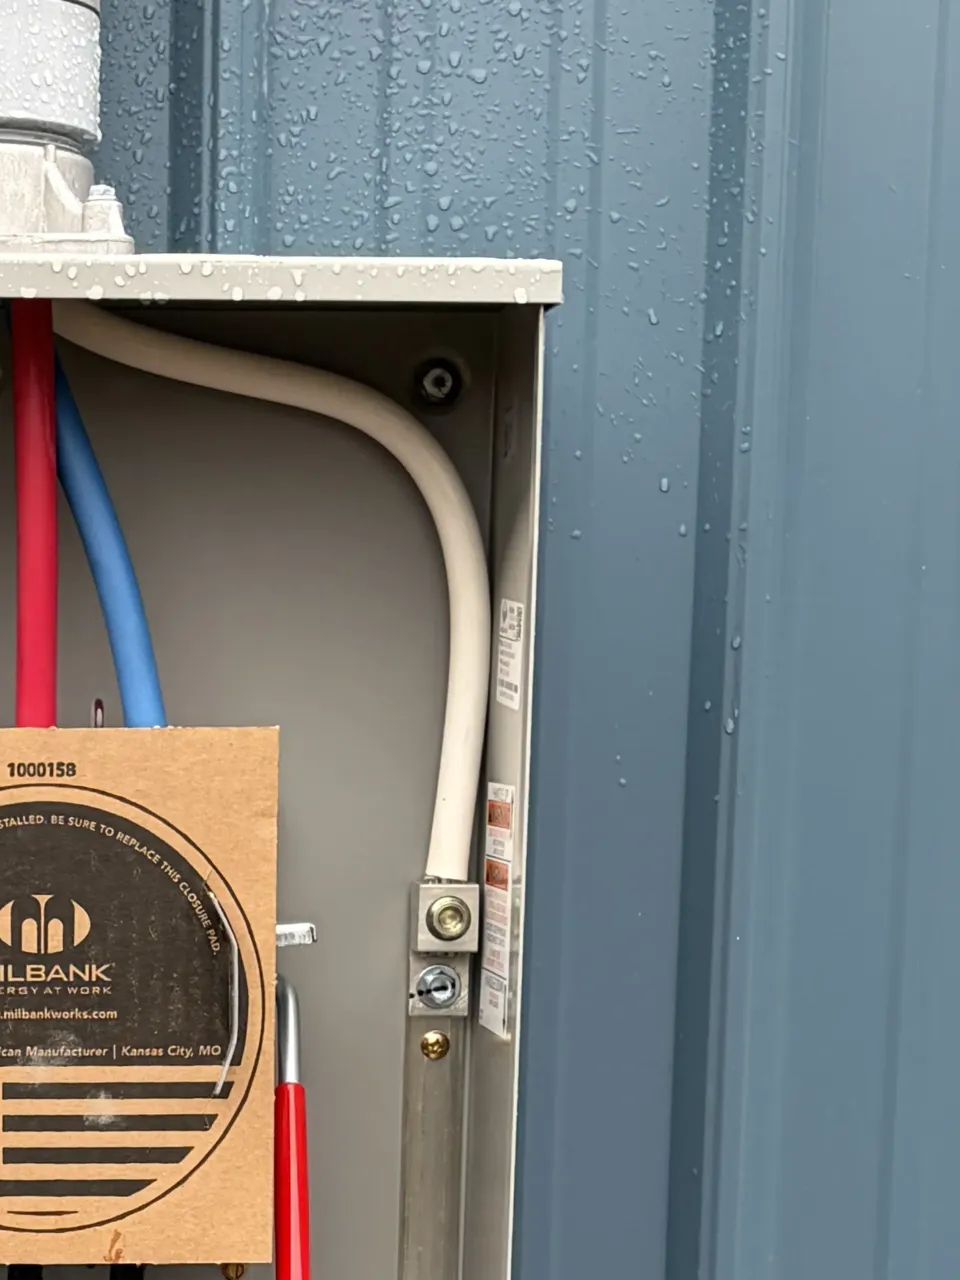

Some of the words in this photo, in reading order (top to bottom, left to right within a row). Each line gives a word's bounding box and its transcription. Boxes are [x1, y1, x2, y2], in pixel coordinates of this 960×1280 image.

[50, 814, 65, 826] BE
[67, 816, 97, 832] SURE
[99, 823, 115, 837] TO
[115, 831, 162, 865] REPLACE
[159, 860, 182, 883] THIS
[178, 881, 212, 928] CLOSURE
[206, 928, 221, 956] PAD.
[43, 986, 63, 996] AT
[67, 985, 113, 996] WORK
[25, 1045, 109, 1058] Manufacturer
[120, 1045, 164, 1057] Kansas
[167, 1045, 194, 1058] City,
[198, 1044, 222, 1057] MO
